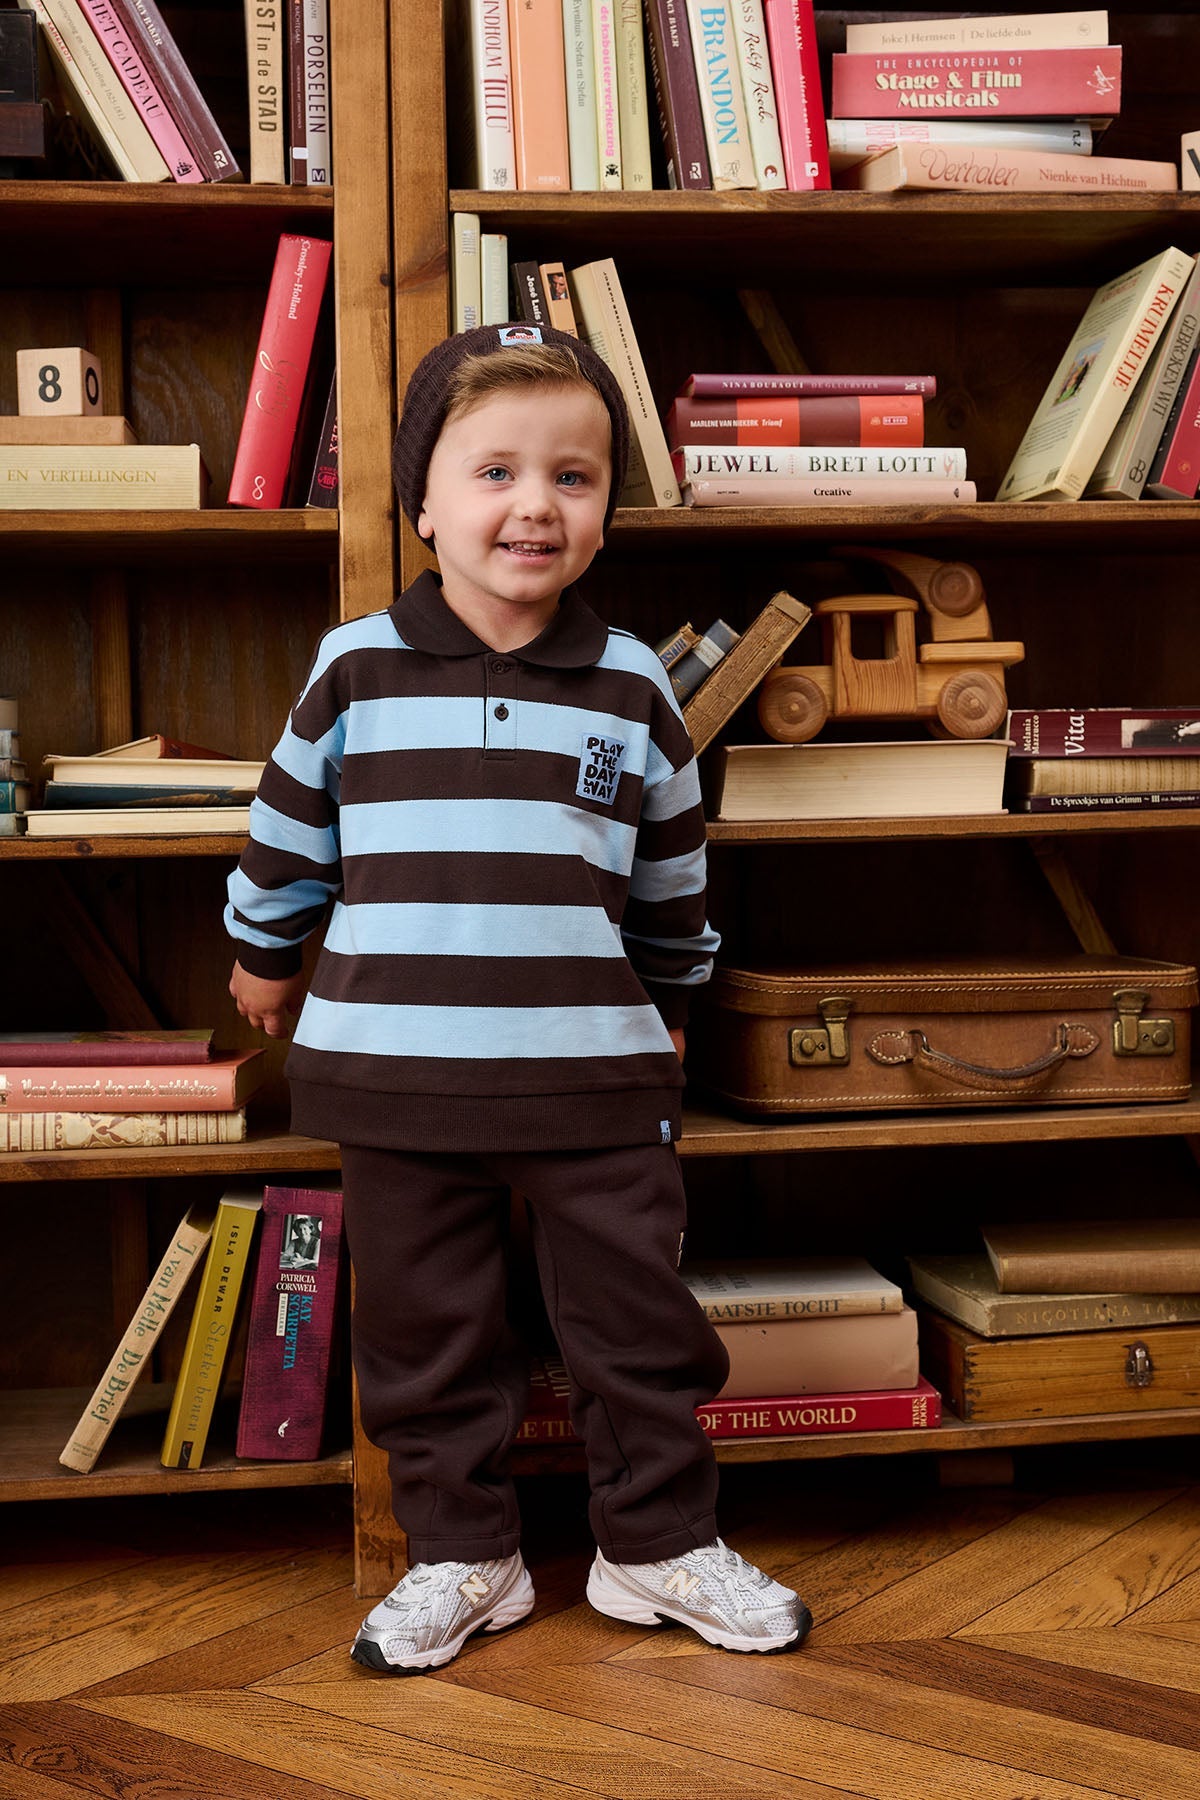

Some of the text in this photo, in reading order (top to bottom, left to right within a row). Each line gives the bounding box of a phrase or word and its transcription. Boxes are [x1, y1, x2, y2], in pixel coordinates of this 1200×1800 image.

[600, 6, 609, 21] de
[143, 17, 163, 46] BAKER
[257, 37, 271, 51] in
[668, 17, 679, 48] BAKER
[793, 25, 803, 50] MAN
[881, 34, 902, 45] Joke
[910, 31, 956, 43] Hermsen
[970, 30, 985, 40] De
[575, 41, 584, 68] Stefan
[743, 30, 762, 70] Ruby
[876, 56, 1023, 69] THE ENCYCLOPEDIA OF
[112, 40, 165, 118] CADEAU
[257, 59, 271, 77] de
[700, 7, 739, 145] BRANDON
[875, 70, 1022, 91] Stage & Film
[307, 34, 326, 133] PORSELEIN
[578, 81, 586, 107] Stefan
[257, 85, 277, 132] STAD
[897, 89, 1000, 108] Musicals
[919, 148, 1147, 188] Verhalen Nienke van Hichtum
[287, 238, 312, 320] Crossley-Holland
[526, 275, 538, 299] José
[1113, 283, 1175, 393] KRUIMELTJE
[1163, 314, 1198, 395] GEBROKEN
[38, 365, 62, 402] 8
[722, 381, 747, 389] NINA
[750, 381, 803, 389] BOURAOUI
[690, 419, 718, 428] MARLENE
[719, 419, 733, 428] VAN
[7, 469, 157, 483] EN VERTELLINGEN
[693, 454, 936, 474] JEWEL BRET LOTT
[814, 487, 852, 497] Creative
[1023, 718, 1031, 752] Melania
[1031, 714, 1040, 755] Mazzucco
[1064, 713, 1086, 755] Vita
[585, 764, 617, 785] DAY
[1051, 797, 1062, 806] De
[1063, 796, 1099, 808] Sprookjes
[1100, 797, 1114, 805] van
[1115, 795, 1142, 804] Grimm
[1151, 795, 1160, 803] III
[157, 1258, 180, 1290] van
[275, 1282, 318, 1293] CORNWELL
[280, 1273, 315, 1284] PATRICIA
[134, 1291, 172, 1338] Melle
[300, 1295, 313, 1324] KAY
[703, 1298, 842, 1319] AATSTE TOCHT
[1016, 1305, 1132, 1325] NICOTIANA
[187, 1225, 240, 1432] ISLA DEWAR Sterke benen
[282, 1294, 301, 1370] SCARPETTA
[116, 1348, 143, 1374] De
[91, 1376, 130, 1425] Brief
[919, 1396, 928, 1428] BOOKS
[696, 1406, 857, 1431] OF THE WORLD
[459, 1572, 491, 1605] N
[665, 1568, 701, 1601] N
